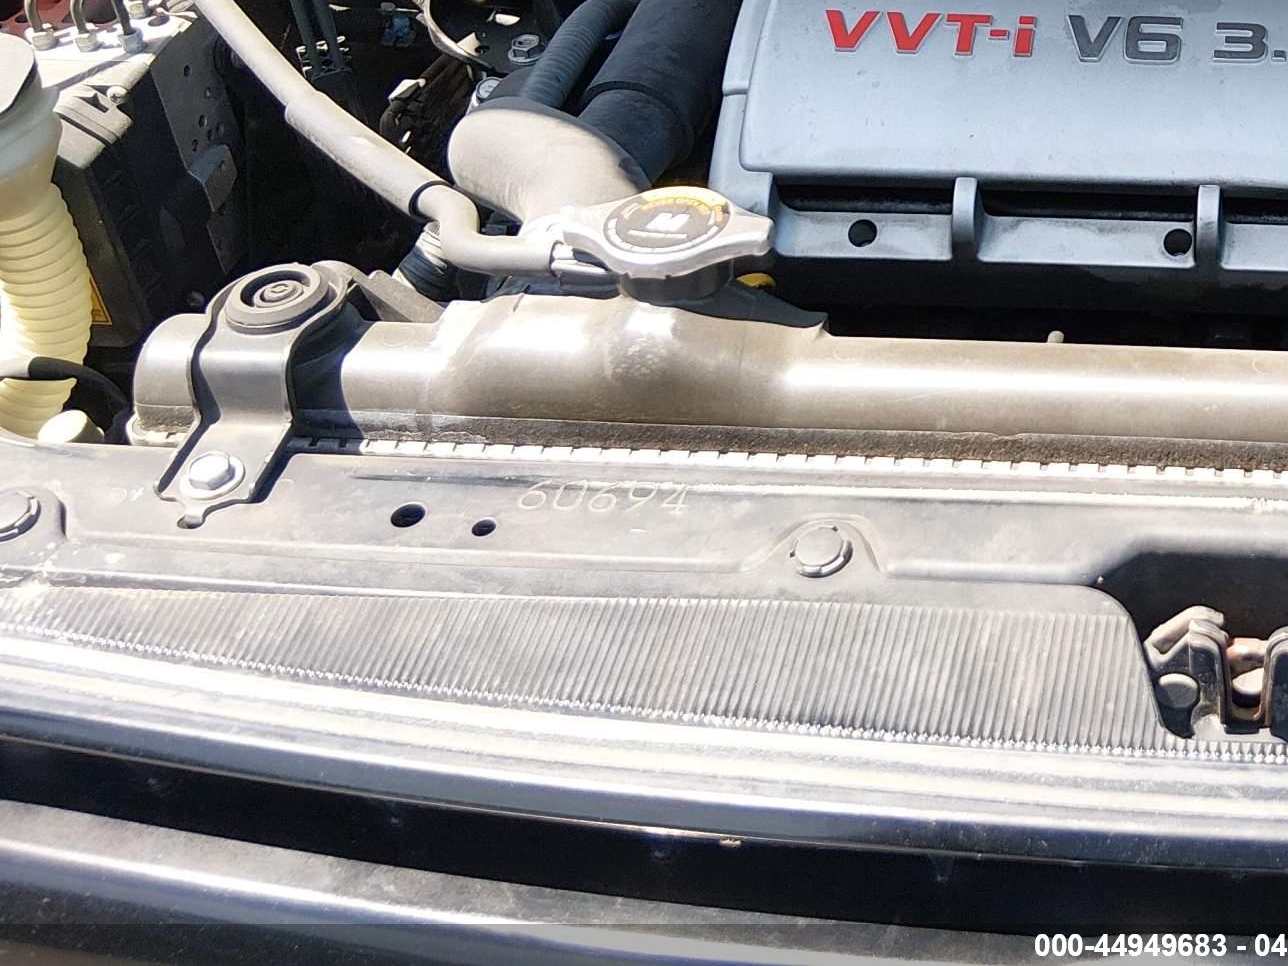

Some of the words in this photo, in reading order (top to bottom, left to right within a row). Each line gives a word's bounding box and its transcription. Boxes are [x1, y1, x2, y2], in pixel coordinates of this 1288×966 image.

[825, 9, 1038, 58] VVT-i
[1066, 13, 1185, 65] V6
[516, 478, 689, 515] 60694
